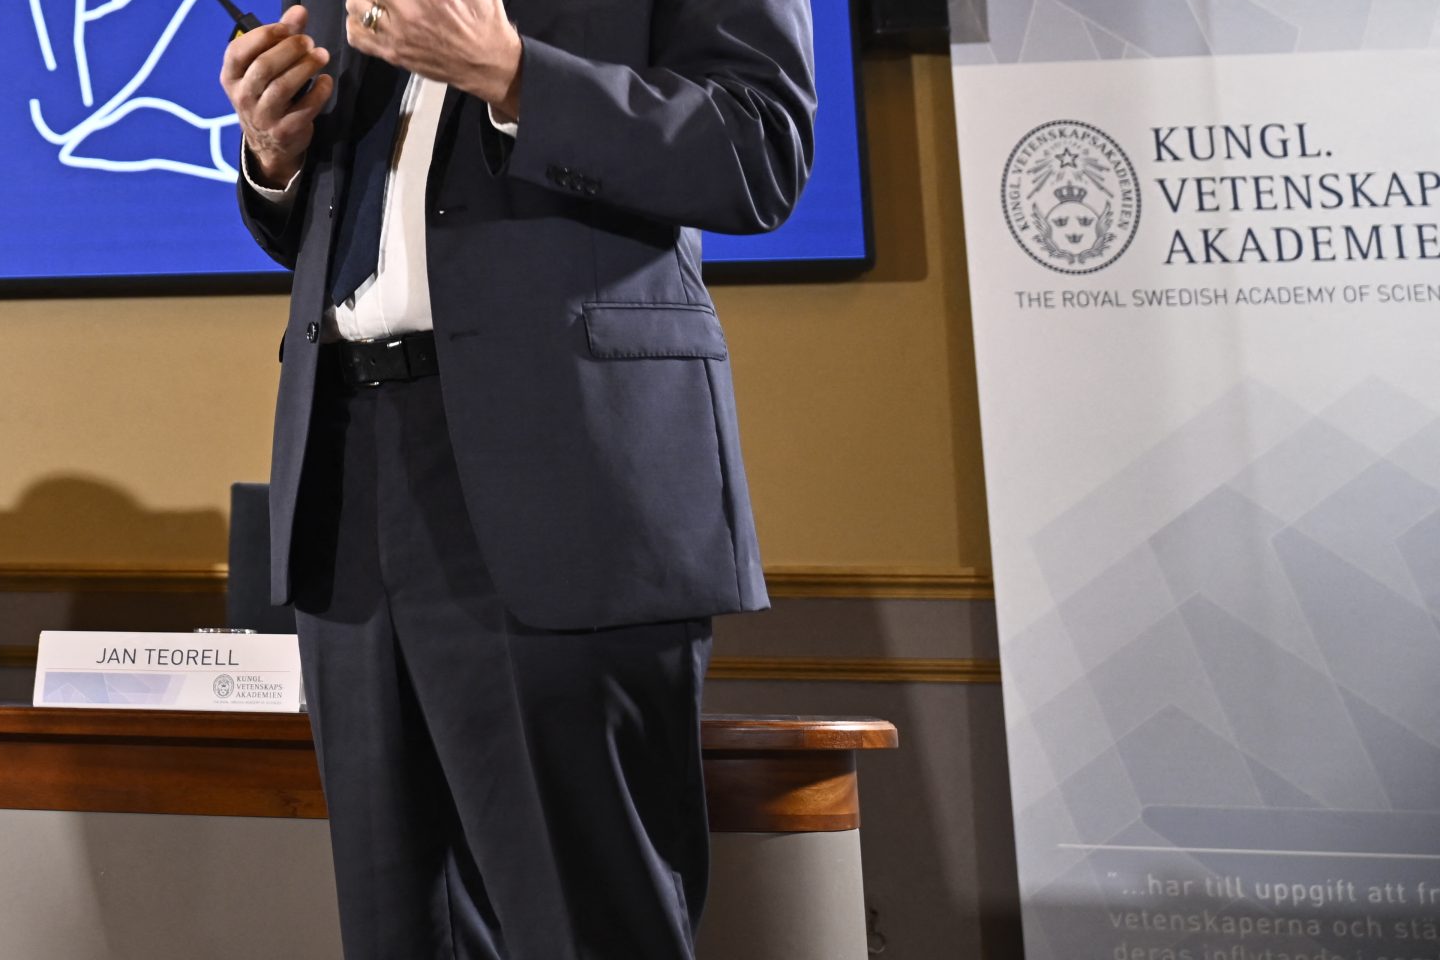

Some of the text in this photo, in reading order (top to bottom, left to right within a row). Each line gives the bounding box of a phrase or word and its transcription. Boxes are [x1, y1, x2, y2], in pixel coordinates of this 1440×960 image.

[1151, 122, 1333, 162] KUNGL.
[1015, 290, 1056, 309] THE
[1062, 290, 1127, 308] ROYAL
[1132, 287, 1228, 307] SWEDISH
[1235, 286, 1336, 305] ACADEMY
[1343, 284, 1370, 303] OF
[96, 648, 240, 666] JAN TEORELL
[1205, 875, 1246, 899] till
[1255, 878, 1357, 908] uppgift
[1367, 882, 1407, 904] att
[1109, 909, 1321, 937] vetenskaperna
[1332, 915, 1383, 938] och
